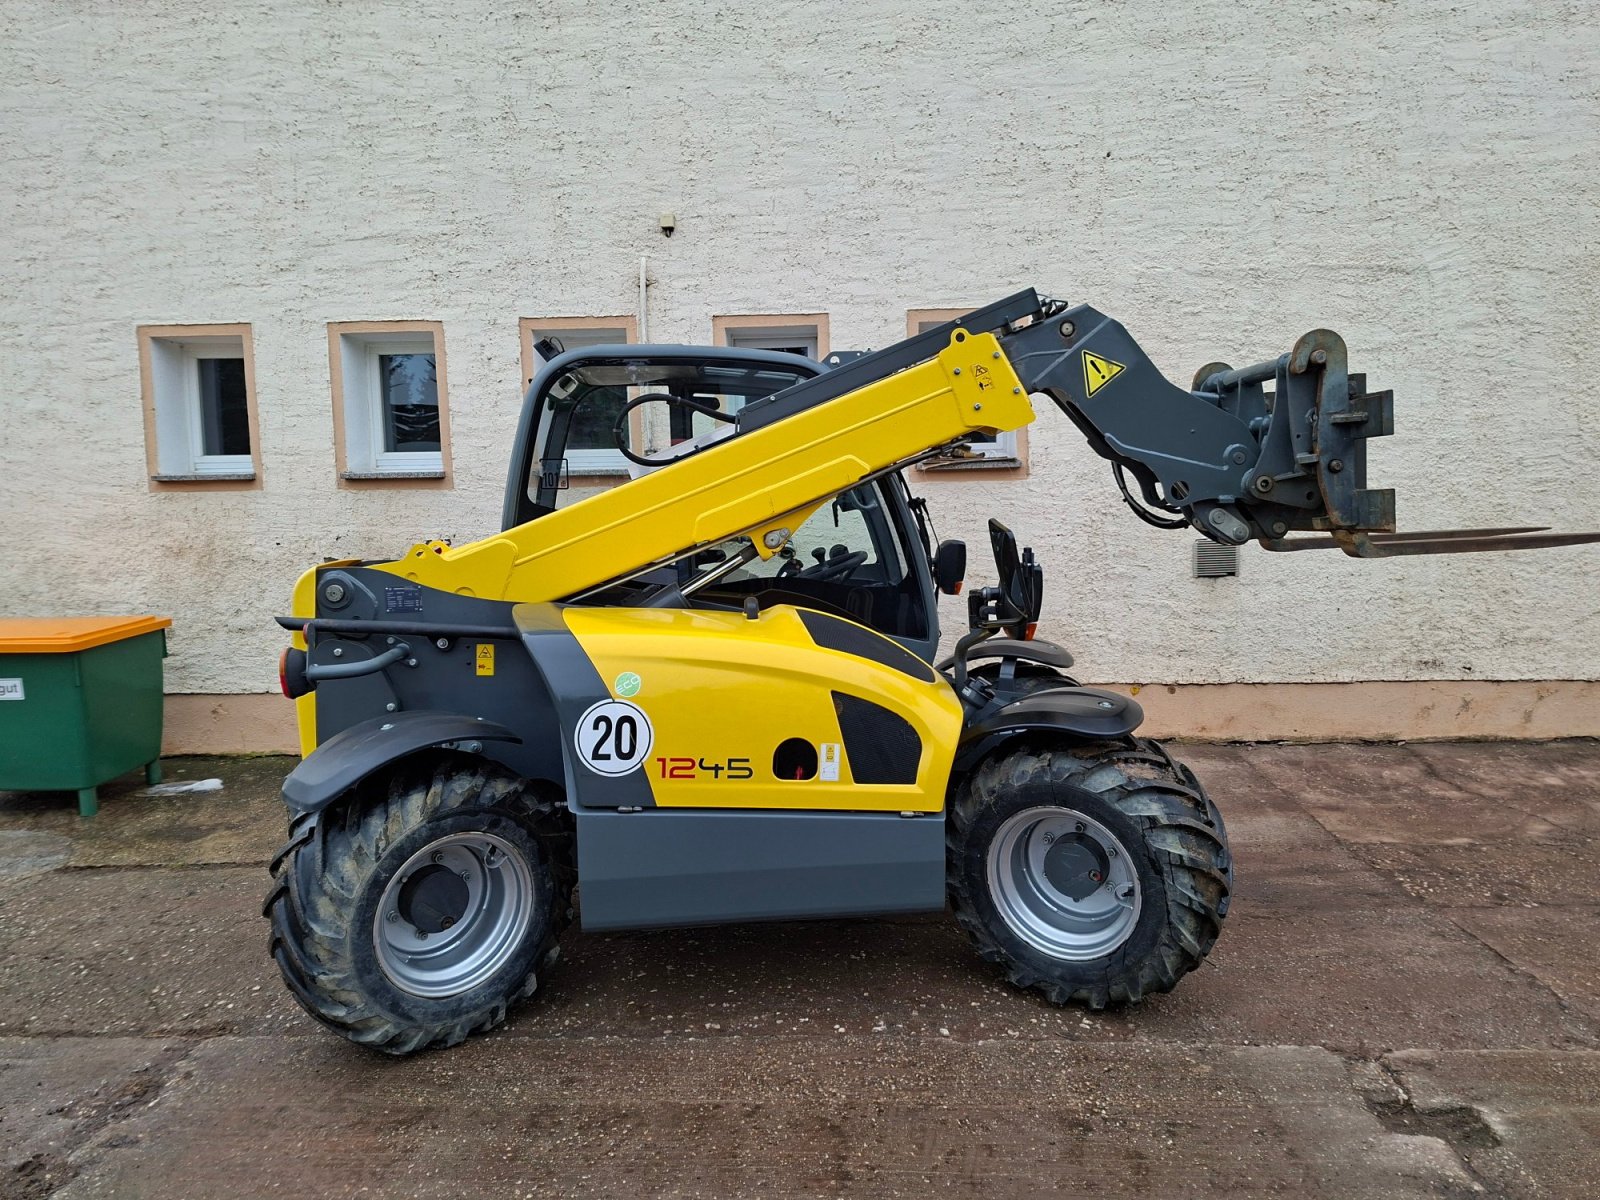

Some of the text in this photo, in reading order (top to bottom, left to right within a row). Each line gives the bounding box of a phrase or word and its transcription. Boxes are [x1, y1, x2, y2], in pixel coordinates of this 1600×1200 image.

[543, 472, 559, 487] 101
[591, 715, 638, 760] 20
[656, 757, 754, 779] 1245
